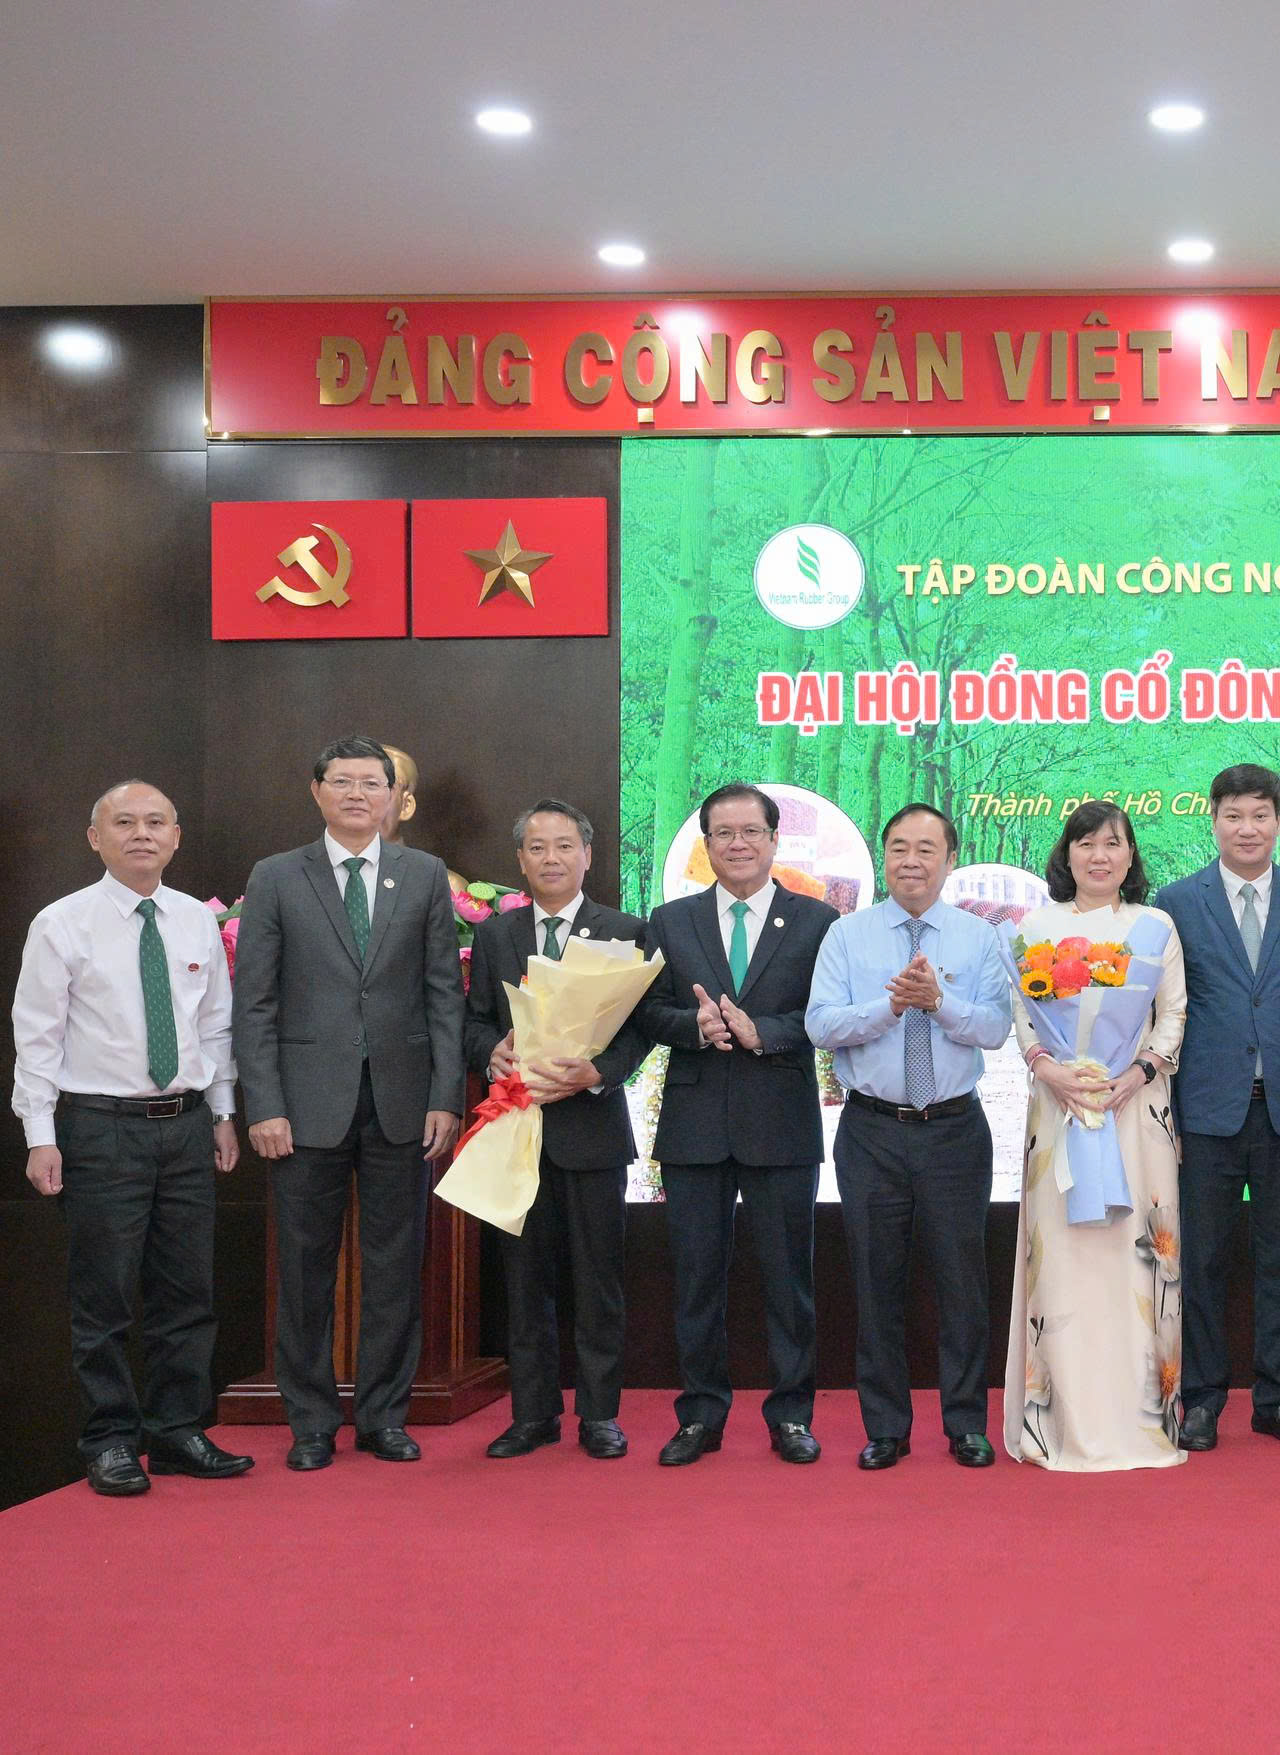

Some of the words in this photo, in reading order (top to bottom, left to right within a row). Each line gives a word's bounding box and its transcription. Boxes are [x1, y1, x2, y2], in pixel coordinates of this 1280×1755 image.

[317, 306, 532, 407] ĐẢNG
[565, 314, 787, 423] CỘNG
[812, 305, 963, 402] SẢN
[993, 311, 1173, 421] VIỆT
[898, 559, 976, 604] TẬP
[985, 557, 1105, 595] ĐOÀN
[1116, 556, 1232, 595] CÔNG
[758, 671, 842, 733] ĐẠI
[856, 665, 941, 733] HỘI
[953, 656, 1088, 723] ĐỒNG
[1104, 652, 1173, 723] CỔ
[968, 792, 1053, 816] Thành
[1123, 790, 1162, 816] Hồ
